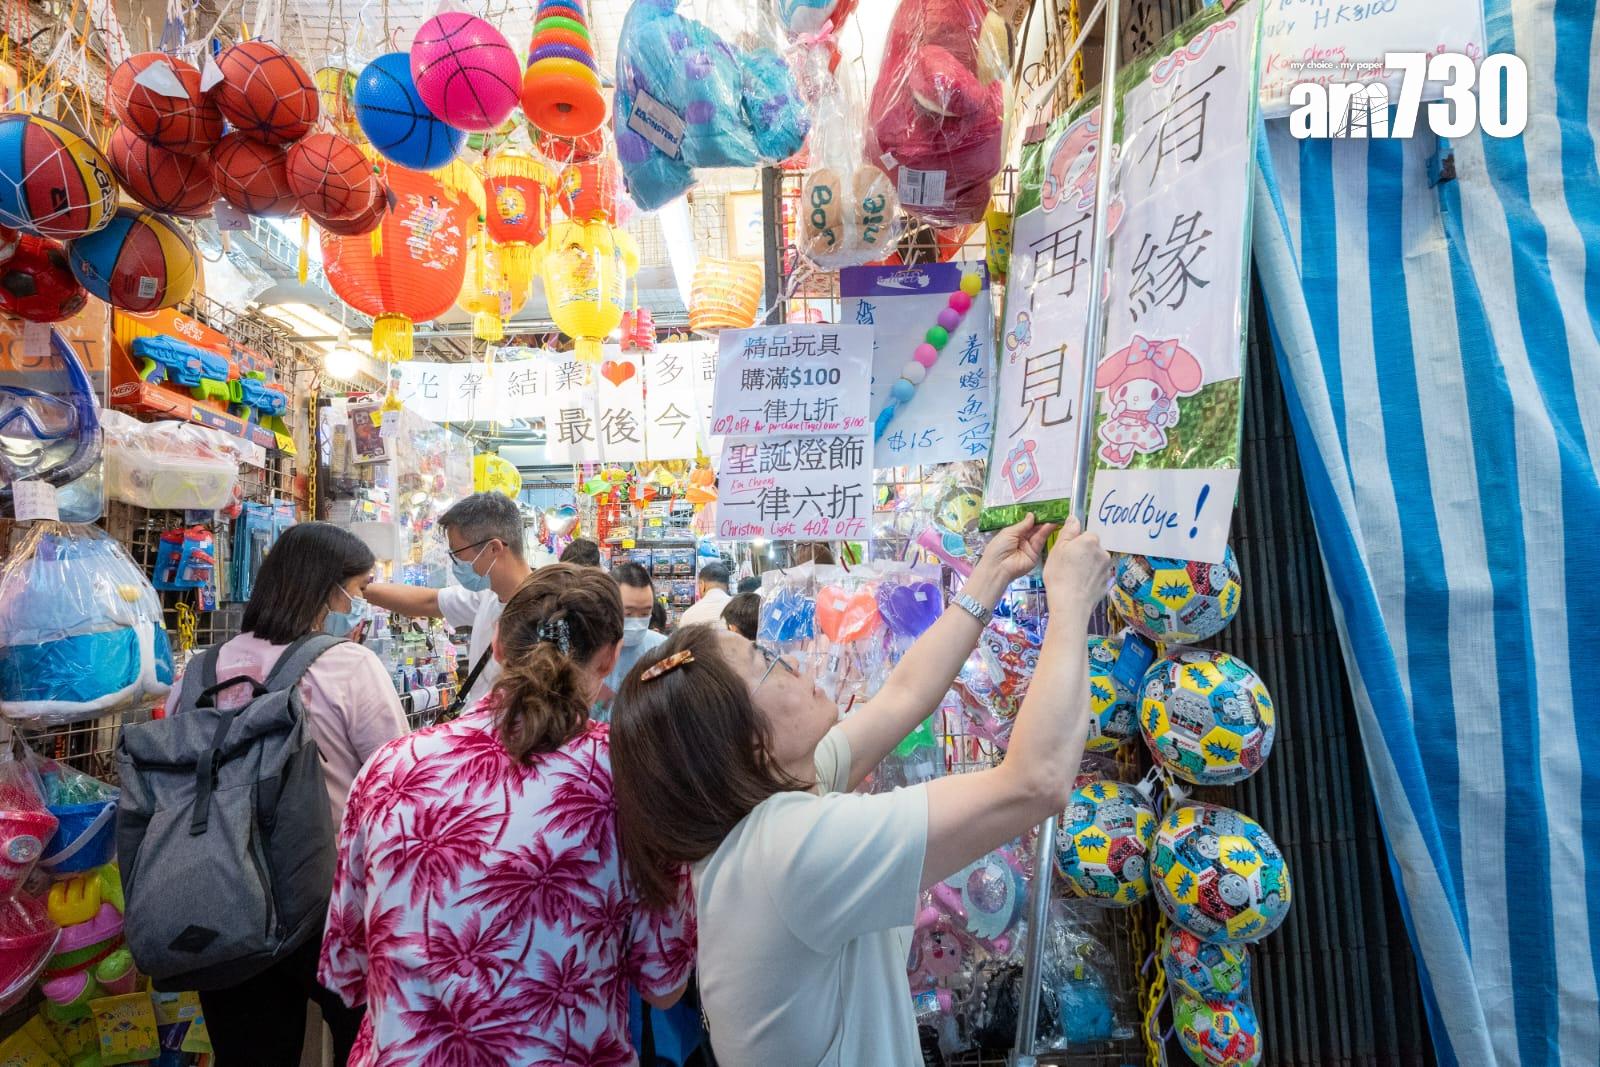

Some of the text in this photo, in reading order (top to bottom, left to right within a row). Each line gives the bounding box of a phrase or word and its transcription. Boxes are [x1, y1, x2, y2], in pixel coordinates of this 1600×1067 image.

[1129, 65, 1226, 324] 有緣
[1009, 213, 1093, 440] 再見
[742, 334, 842, 360] 精品玩具
[406, 360, 584, 399] 光榮結業
[740, 366, 841, 391] 購滿$100
[713, 414, 734, 434] 10%
[738, 397, 839, 422] 一律九折
[726, 436, 864, 475] 聖誕燈飾
[723, 483, 864, 521] 一律六折
[802, 518, 829, 535] 40%
